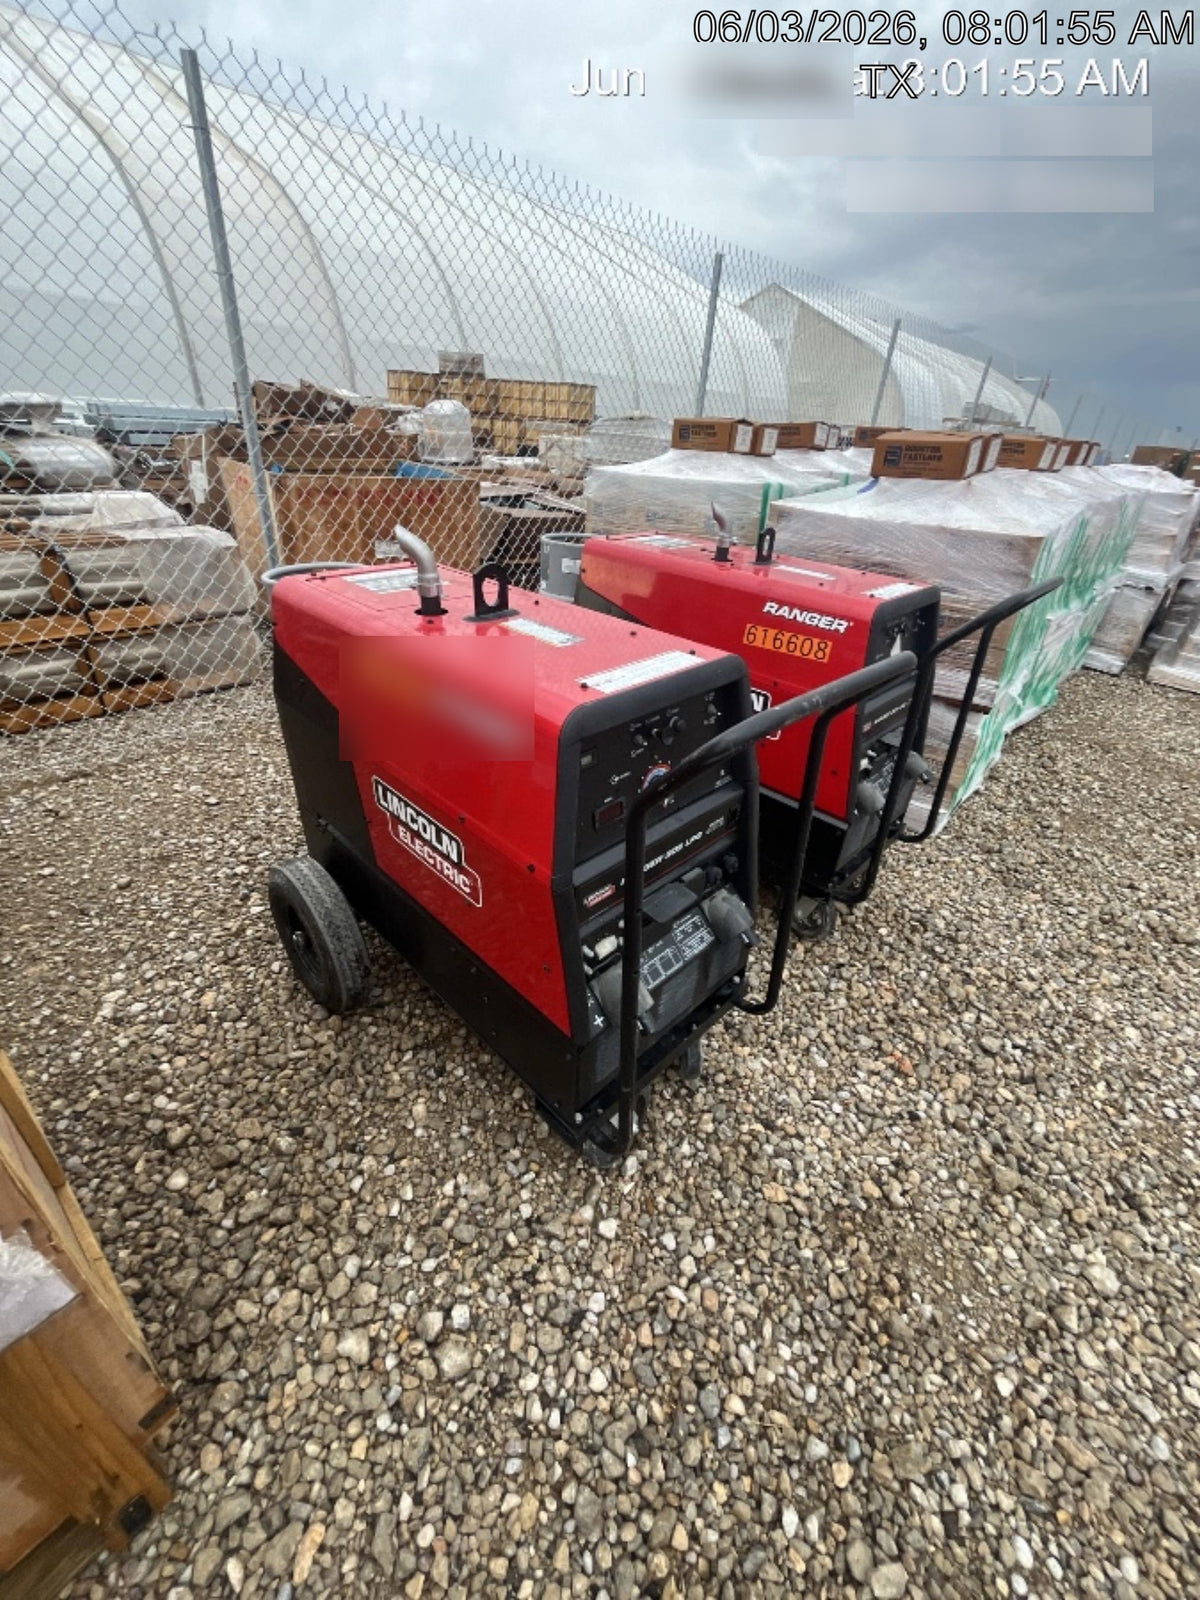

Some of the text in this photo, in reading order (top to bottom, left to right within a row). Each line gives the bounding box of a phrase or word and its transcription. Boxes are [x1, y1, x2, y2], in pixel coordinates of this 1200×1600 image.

[746, 625, 828, 660] 616608
[763, 601, 848, 633] RANGER
[378, 784, 458, 863] LINCOLN
[398, 825, 471, 893] ELECTRIC
